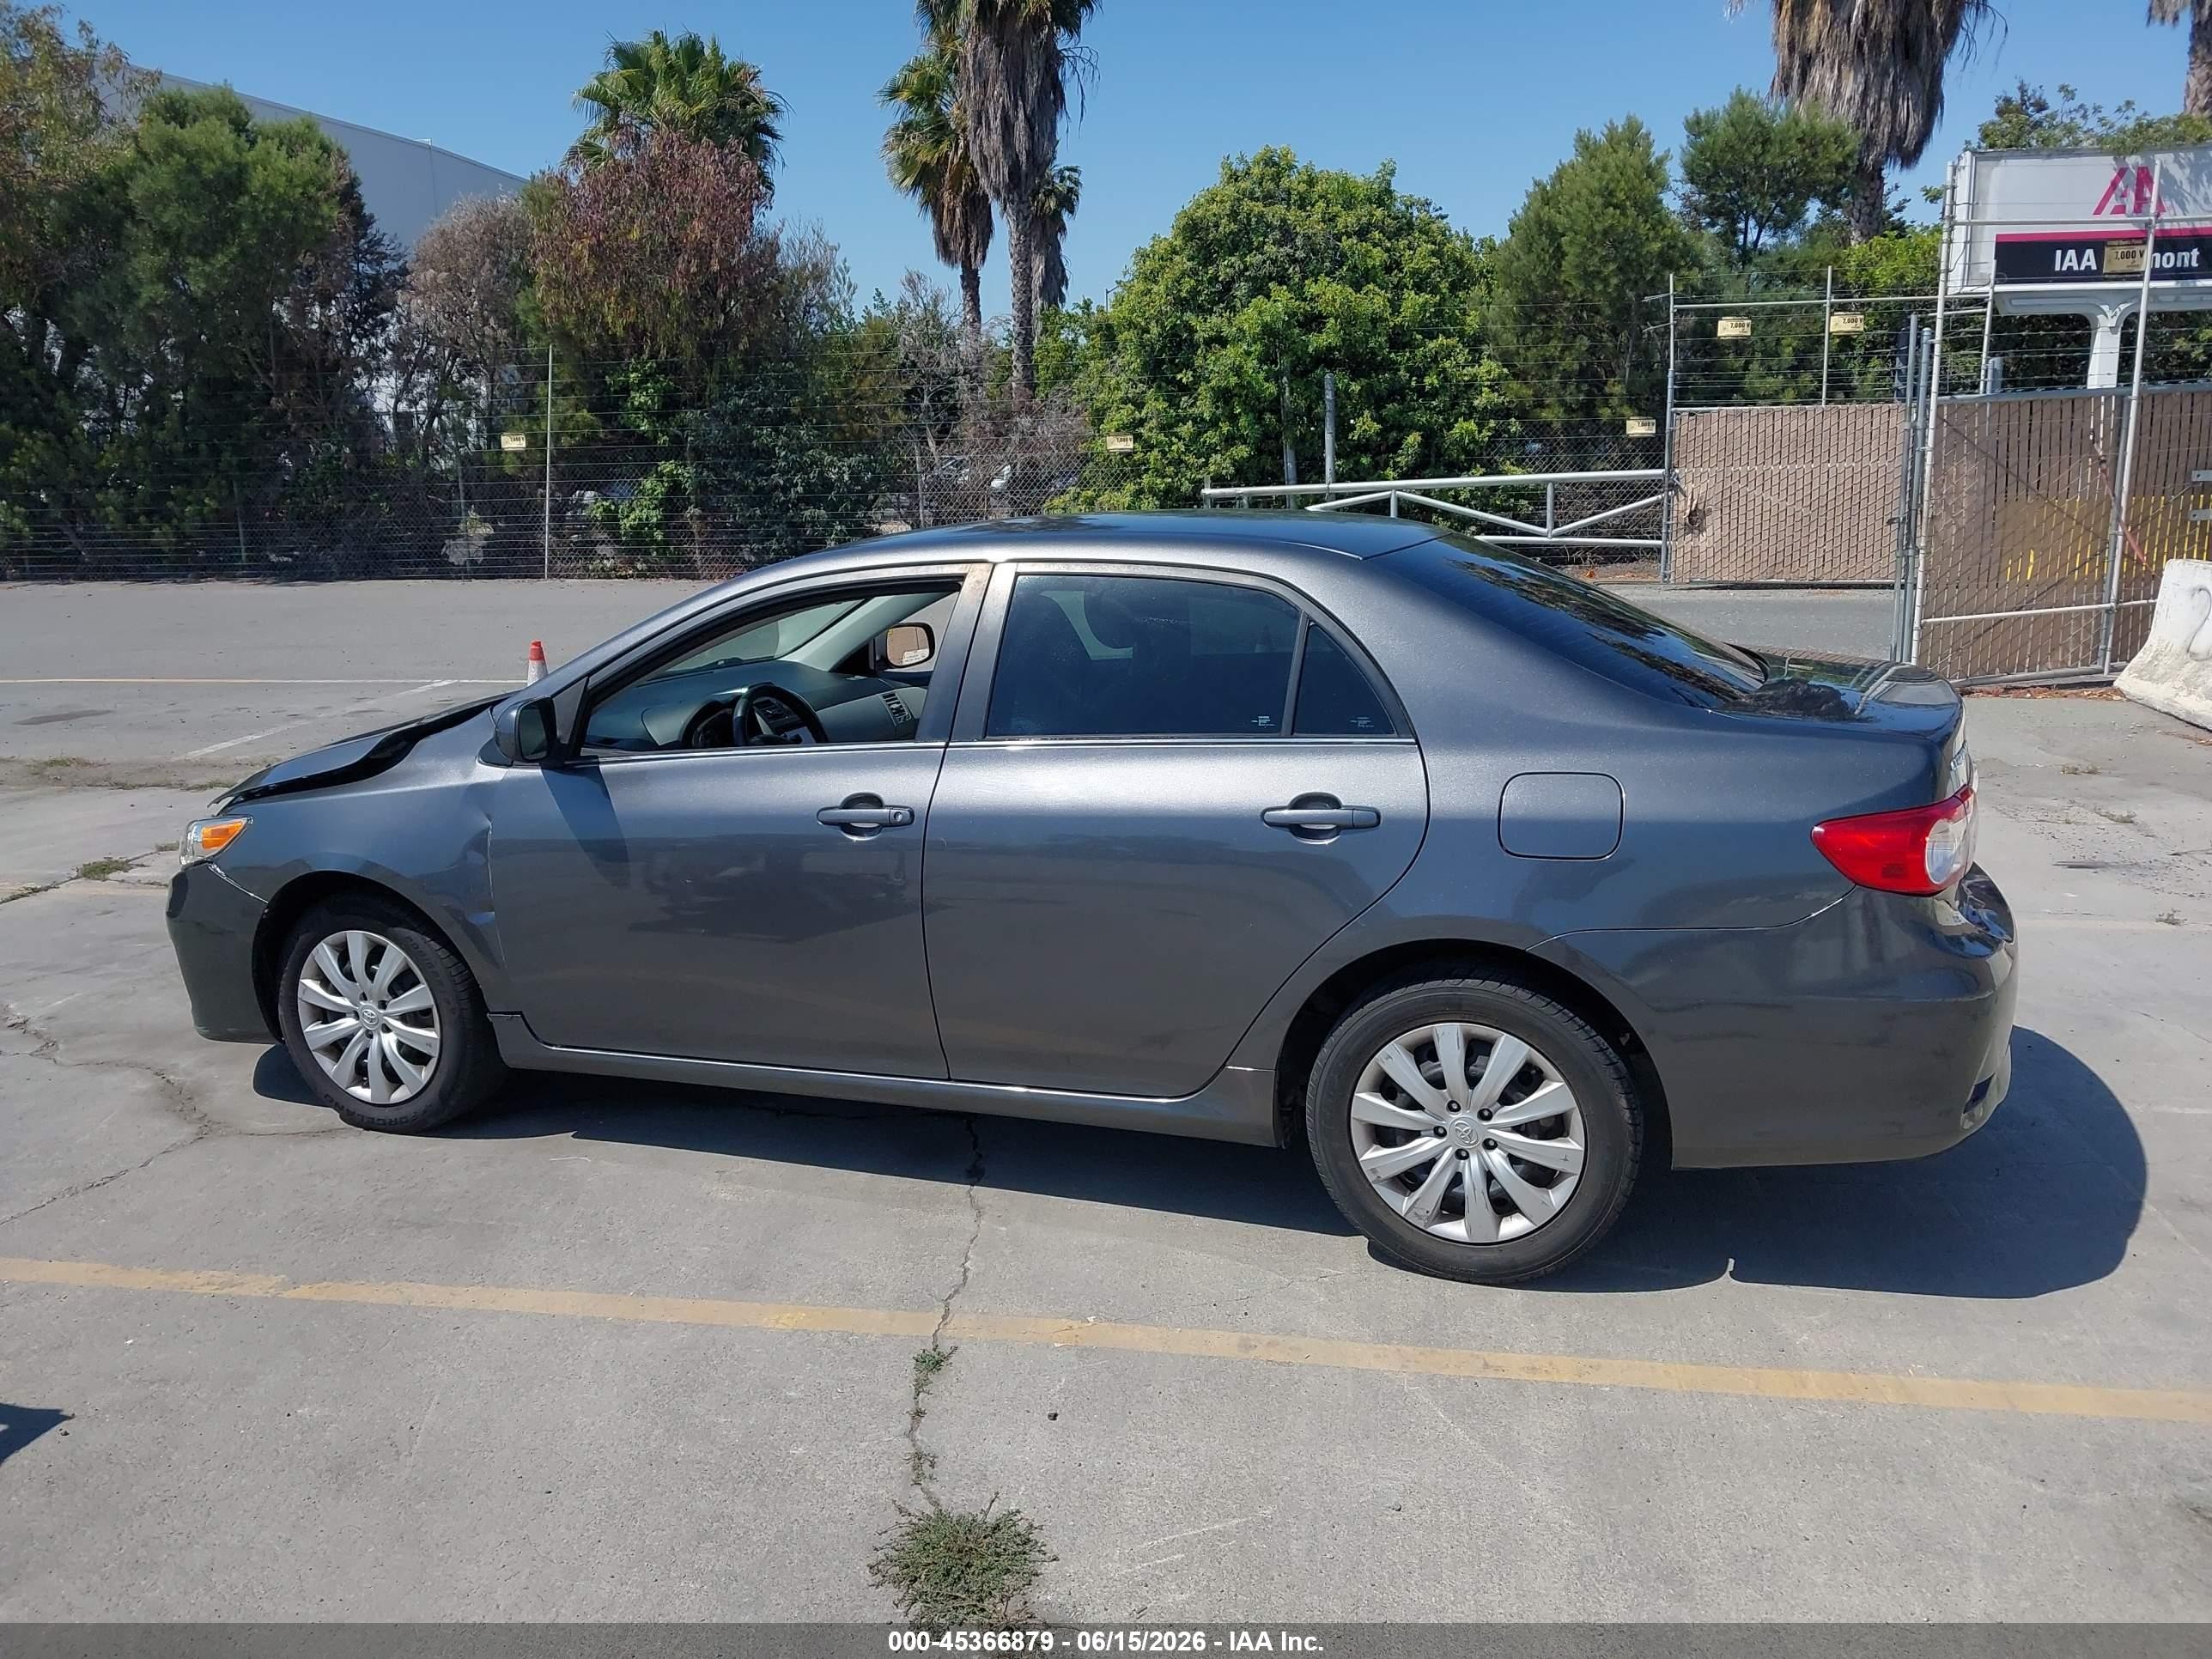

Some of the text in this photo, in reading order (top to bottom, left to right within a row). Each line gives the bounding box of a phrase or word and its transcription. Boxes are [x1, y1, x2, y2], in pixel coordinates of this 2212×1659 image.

[2054, 248, 2097, 271] IAA
[2115, 249, 2145, 261] 7,000 V
